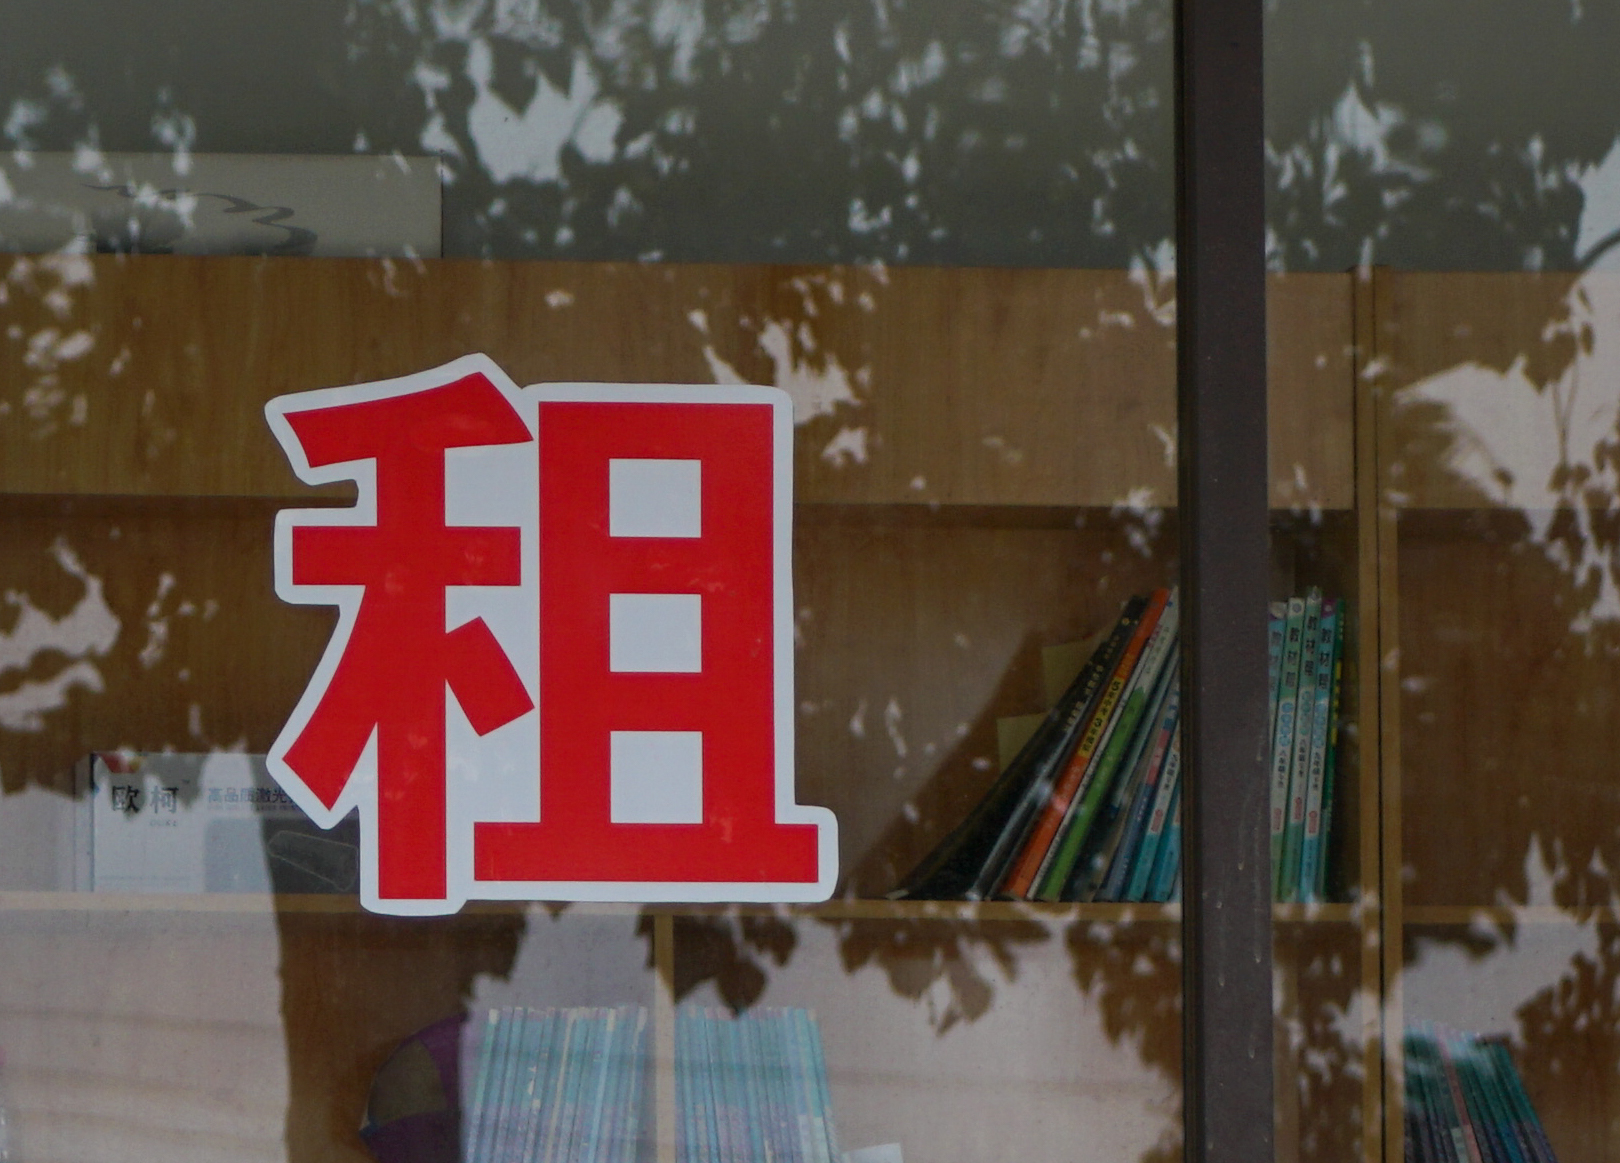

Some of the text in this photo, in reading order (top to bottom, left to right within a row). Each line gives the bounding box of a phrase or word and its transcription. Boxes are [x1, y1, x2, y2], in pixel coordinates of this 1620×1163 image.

[207, 786, 291, 804] 高品质激光
